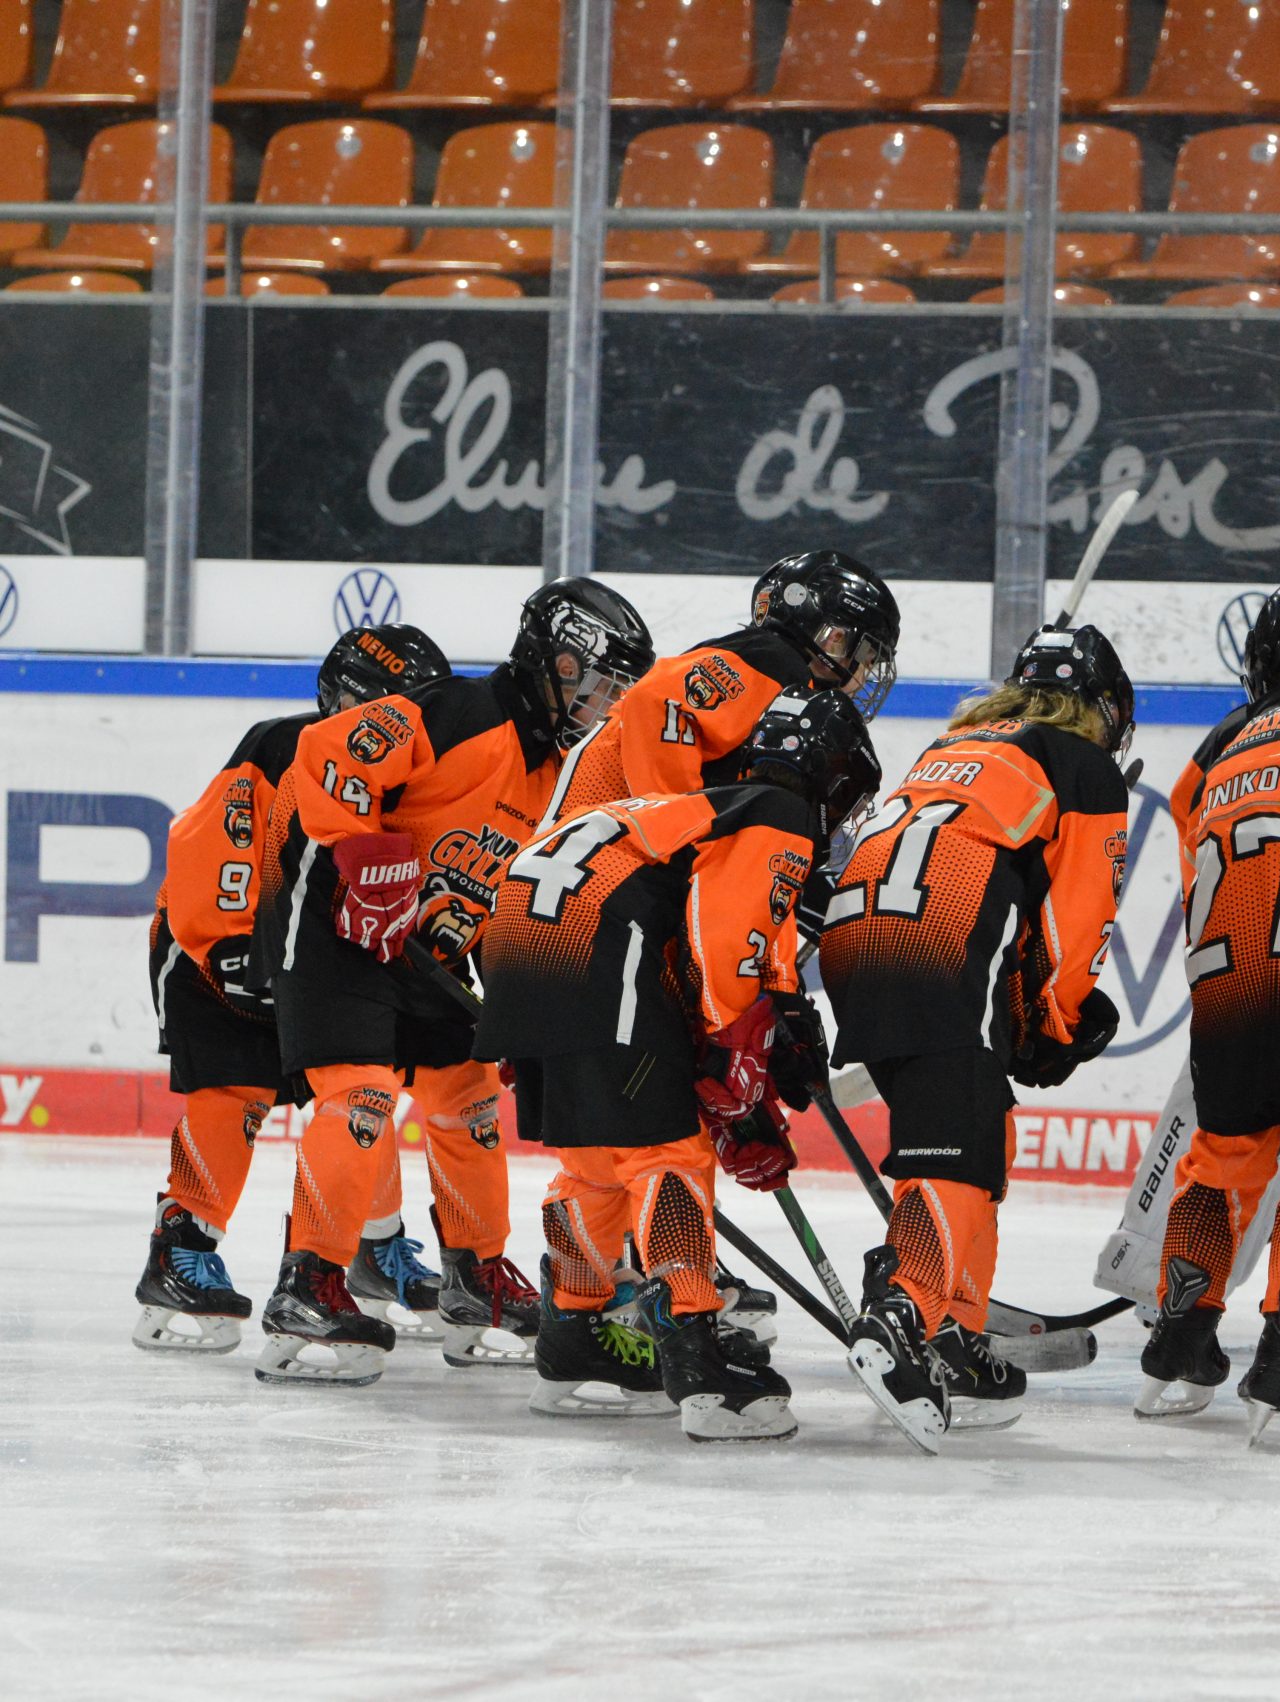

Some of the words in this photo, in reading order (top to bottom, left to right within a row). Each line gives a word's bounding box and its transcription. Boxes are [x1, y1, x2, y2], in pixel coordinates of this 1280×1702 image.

[737, 386, 889, 522] de
[843, 597, 866, 612] CCM
[357, 632, 405, 676] NEVIO
[341, 673, 368, 694] CCM
[322, 758, 373, 816] 14
[216, 860, 253, 912] 9
[820, 793, 970, 930] 21
[897, 1147, 962, 1157] SHERWOOD
[1138, 1115, 1186, 1214] BAUER
